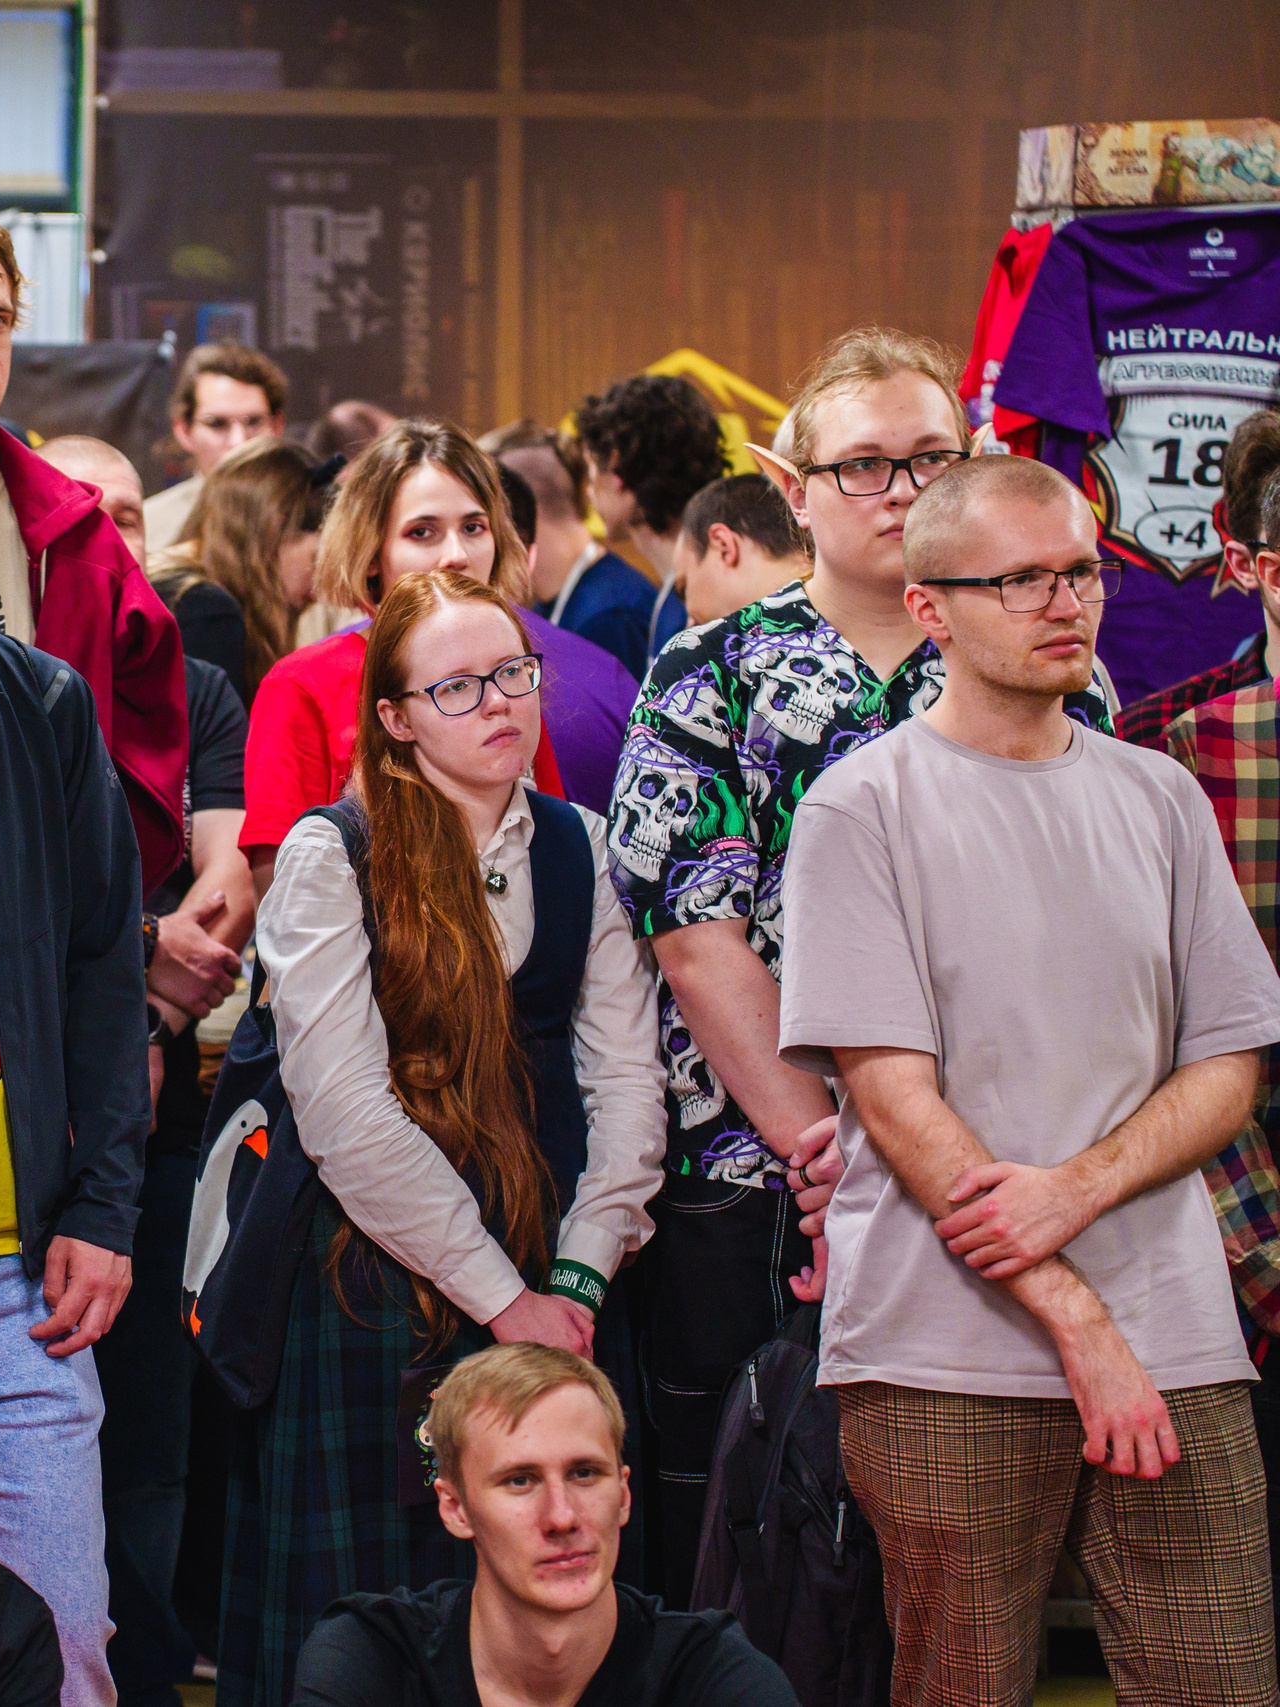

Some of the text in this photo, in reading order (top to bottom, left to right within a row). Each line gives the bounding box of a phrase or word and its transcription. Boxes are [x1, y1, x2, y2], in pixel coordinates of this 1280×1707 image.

[1168, 412, 1227, 431] СИЛА
[1148, 438, 1230, 488] 18
[1159, 520, 1208, 550] +4
